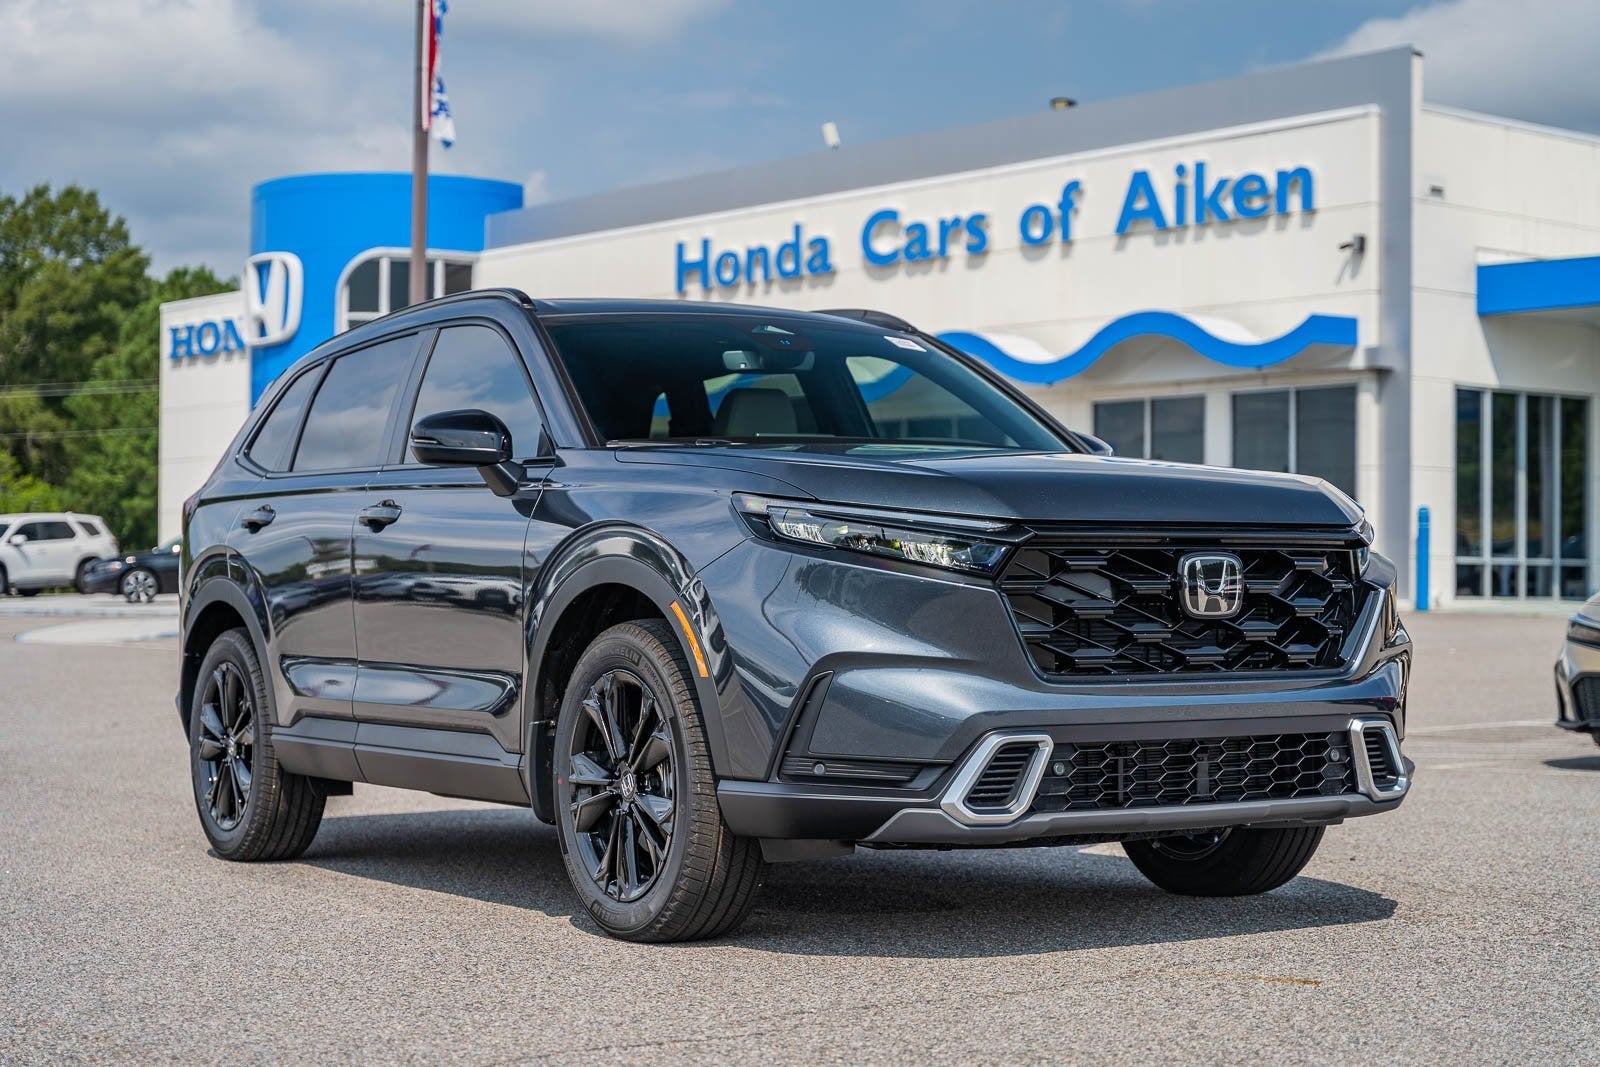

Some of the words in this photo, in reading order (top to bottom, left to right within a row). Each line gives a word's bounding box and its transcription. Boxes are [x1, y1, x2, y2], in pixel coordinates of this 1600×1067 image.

[675, 222, 834, 294] Honda
[860, 208, 988, 268] Cars
[1018, 179, 1082, 248] of
[1114, 161, 1314, 237] Aiken
